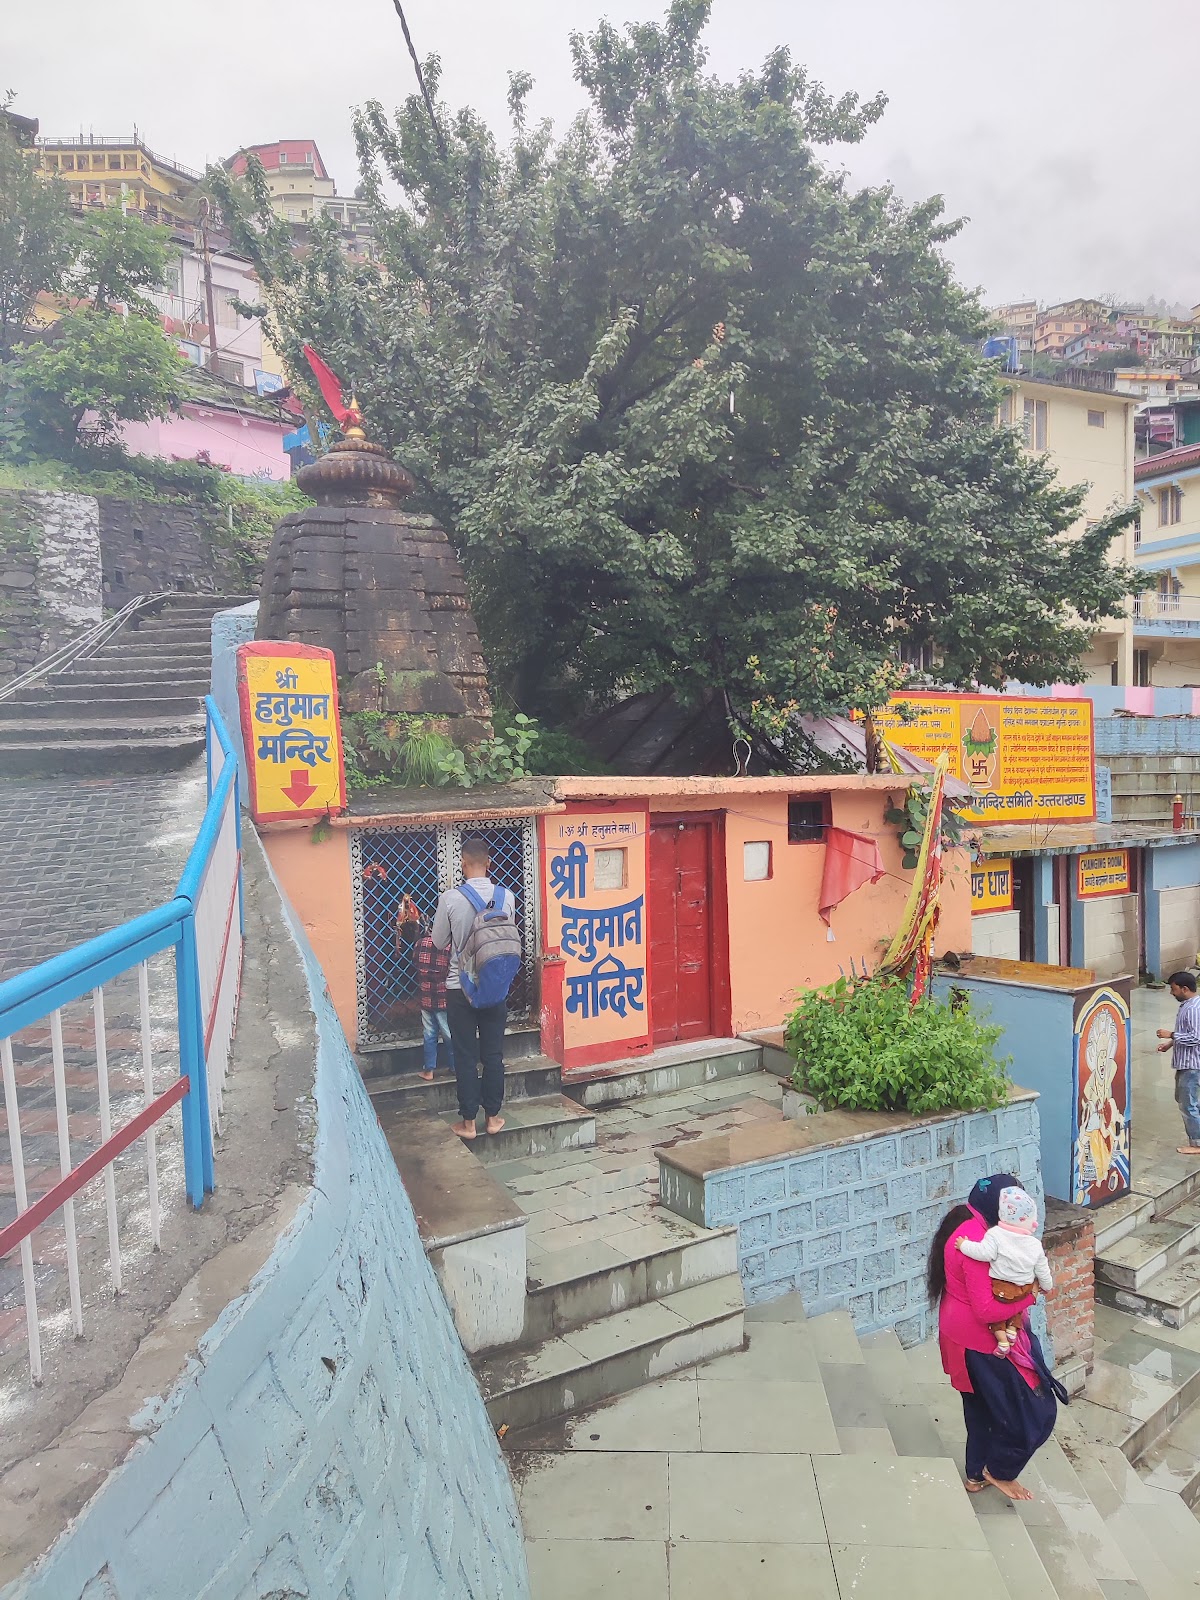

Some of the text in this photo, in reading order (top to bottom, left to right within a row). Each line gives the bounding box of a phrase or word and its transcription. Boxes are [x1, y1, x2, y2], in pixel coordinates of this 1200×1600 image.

[275, 667, 298, 689] श्री
[255, 693, 329, 726] हनुमान
[258, 728, 332, 767] मन्दिर
[978, 792, 1005, 810] मन्दिर
[1006, 790, 1033, 808] समिति
[591, 821, 618, 840] हनुमते
[549, 841, 588, 900] श्री
[1081, 855, 1122, 871] CHANGING ROOM
[987, 870, 1009, 897] धारा
[561, 893, 644, 963] हनुमान
[566, 953, 644, 1019] मन्दिर
